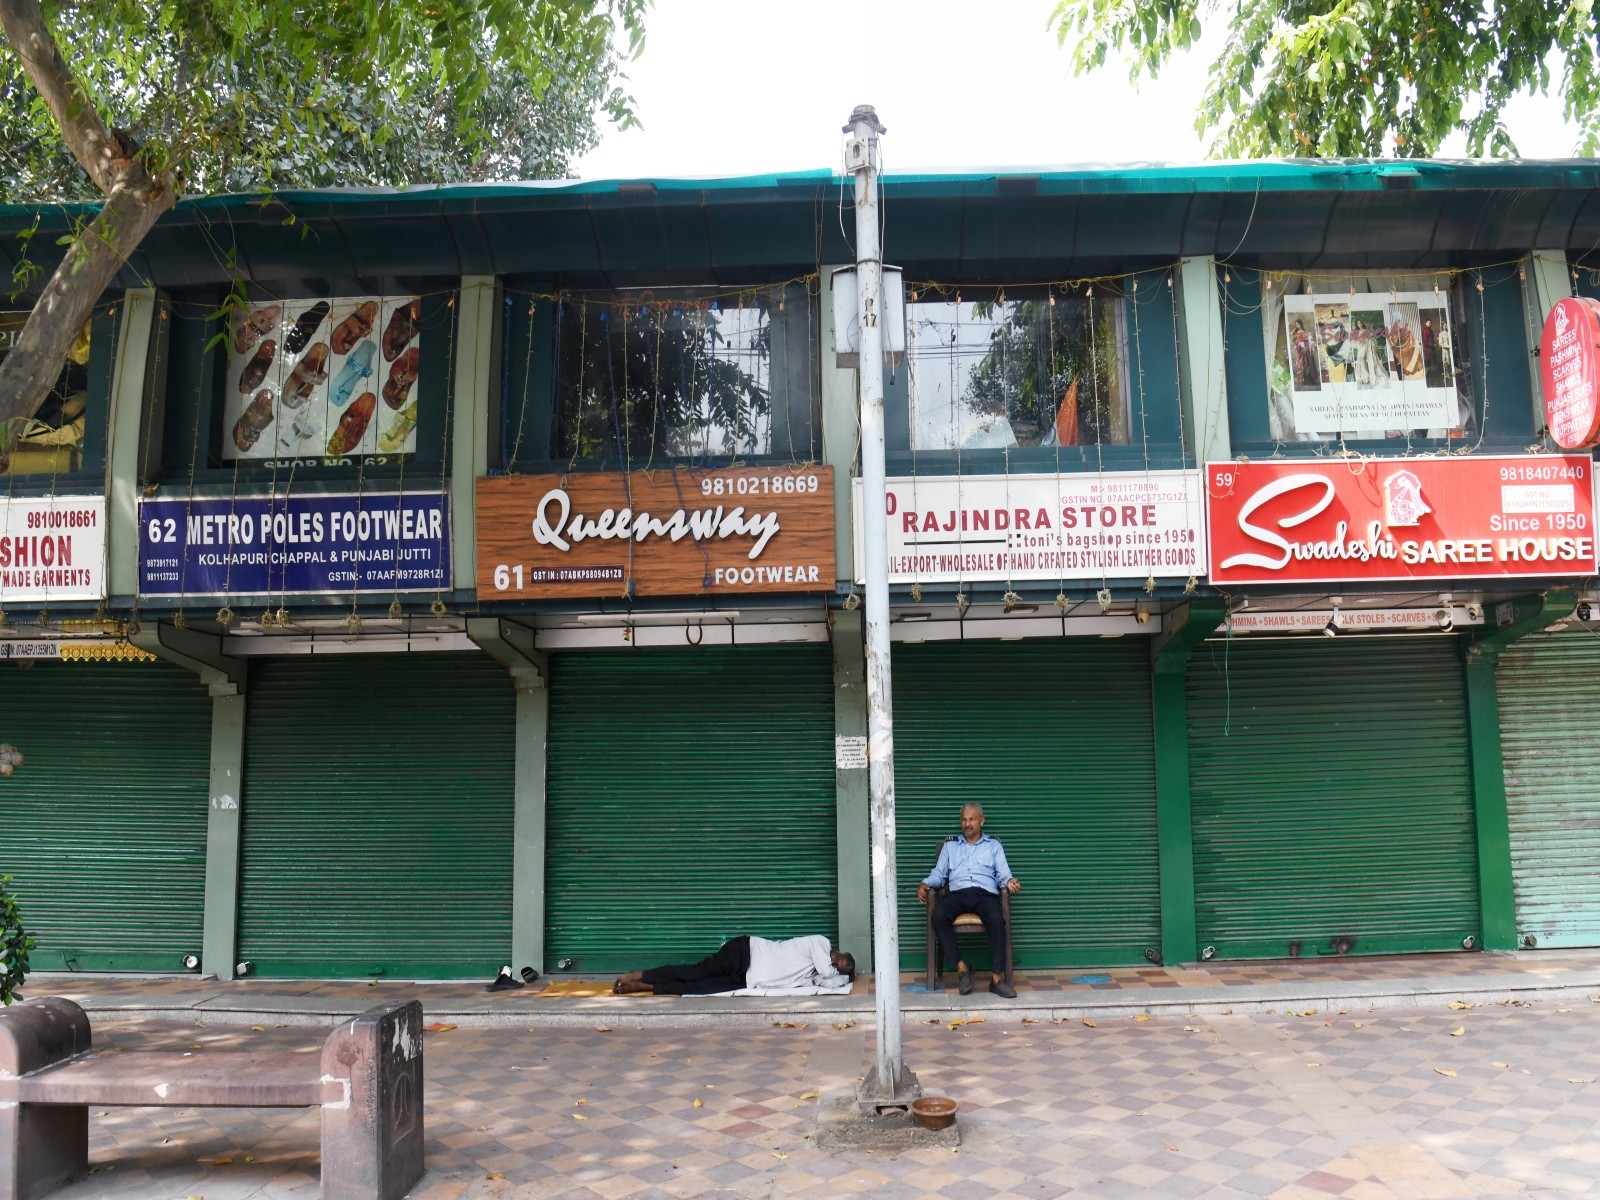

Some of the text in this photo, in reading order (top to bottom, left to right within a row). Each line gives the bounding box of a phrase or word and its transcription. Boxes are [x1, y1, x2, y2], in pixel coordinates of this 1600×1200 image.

[1552, 329, 1577, 351] SAREES
[1550, 341, 1582, 367] PASHMINA
[1215, 473, 1233, 487] 59
[1500, 465, 1584, 480] 9818407440
[701, 475, 818, 496] 9810218669
[1107, 483, 1159, 492] 9811170890
[1062, 496, 1088, 504] GSTIN
[27, 510, 96, 529] 9810018661
[148, 508, 442, 545] 62 METRO POLES FOOTWEAR
[532, 488, 780, 560] Queensway
[902, 504, 1157, 533] RAJINDRA STORE
[1220, 473, 1593, 570] Swadeshi SAREE HOUSE
[1490, 513, 1586, 531] Since 1950
[1024, 532, 1062, 548] toni's
[1125, 530, 1161, 544] since
[1164, 528, 1195, 544] 1950
[198, 548, 431, 566] KOLHAPURI CHAPPAL & PUNJABI JUTTI
[888, 553, 994, 574] IL-EXPORT-WHOLESALE
[996, 552, 1008, 571] OF
[1010, 552, 1035, 570] HAND
[1080, 550, 1119, 568] STYLISH
[1122, 548, 1162, 567] LEATHER
[1165, 548, 1196, 566] GOODS
[0, 568, 91, 588] MADE GARMENTS
[493, 564, 524, 591] 61
[533, 572, 546, 580] GST
[714, 565, 820, 585] FOOTWEAR
[1264, 616, 1295, 626] SHAWLS
[1302, 614, 1330, 626] SAREES
[1357, 613, 1386, 624] STOLES
[1392, 612, 1426, 623] SCARVES
